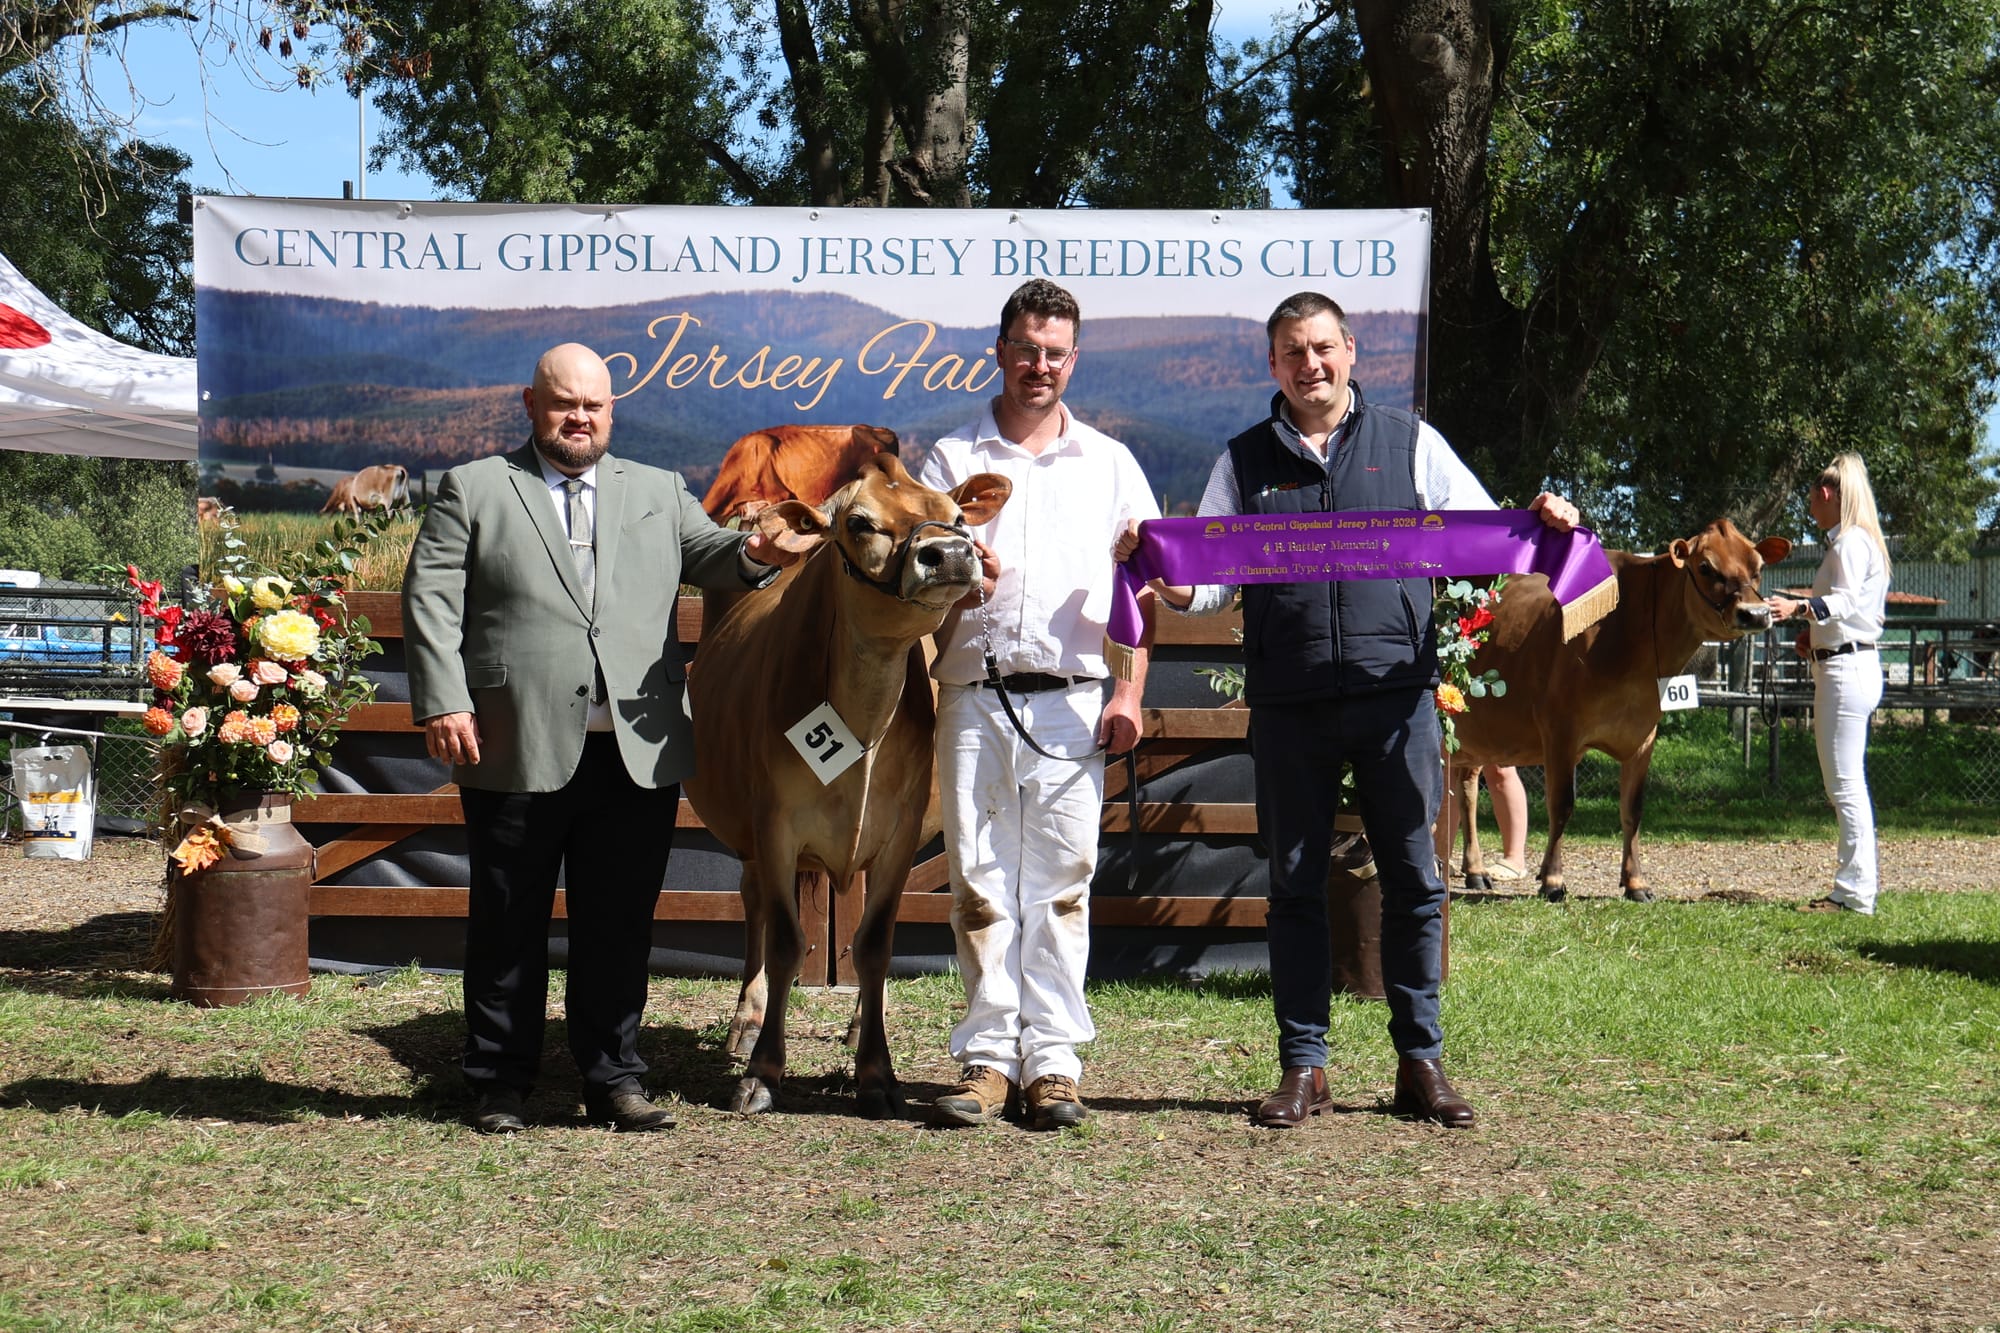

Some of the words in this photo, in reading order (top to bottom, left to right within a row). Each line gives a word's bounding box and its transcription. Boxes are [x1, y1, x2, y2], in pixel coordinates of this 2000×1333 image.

[235, 227, 481, 271] CENTRAL
[498, 233, 781, 274] GIPPSLAND
[792, 237, 976, 283] JERSEY
[991, 238, 1243, 278] BREEDERS
[1260, 239, 1397, 278] CLUB
[603, 311, 844, 411] Jersey
[857, 319, 1001, 400] Fai
[1253, 521, 1287, 532] Central
[1289, 519, 1333, 531] Gippsland
[1336, 519, 1367, 530] Jersey
[1370, 517, 1390, 528] Fair
[1330, 539, 1379, 551] Memorial
[1239, 564, 1288, 577] Champion
[1292, 562, 1319, 575] Type
[1322, 562, 1332, 573] &
[1335, 561, 1389, 573] Production
[1667, 684, 1689, 702] 60
[805, 721, 845, 764] 51
